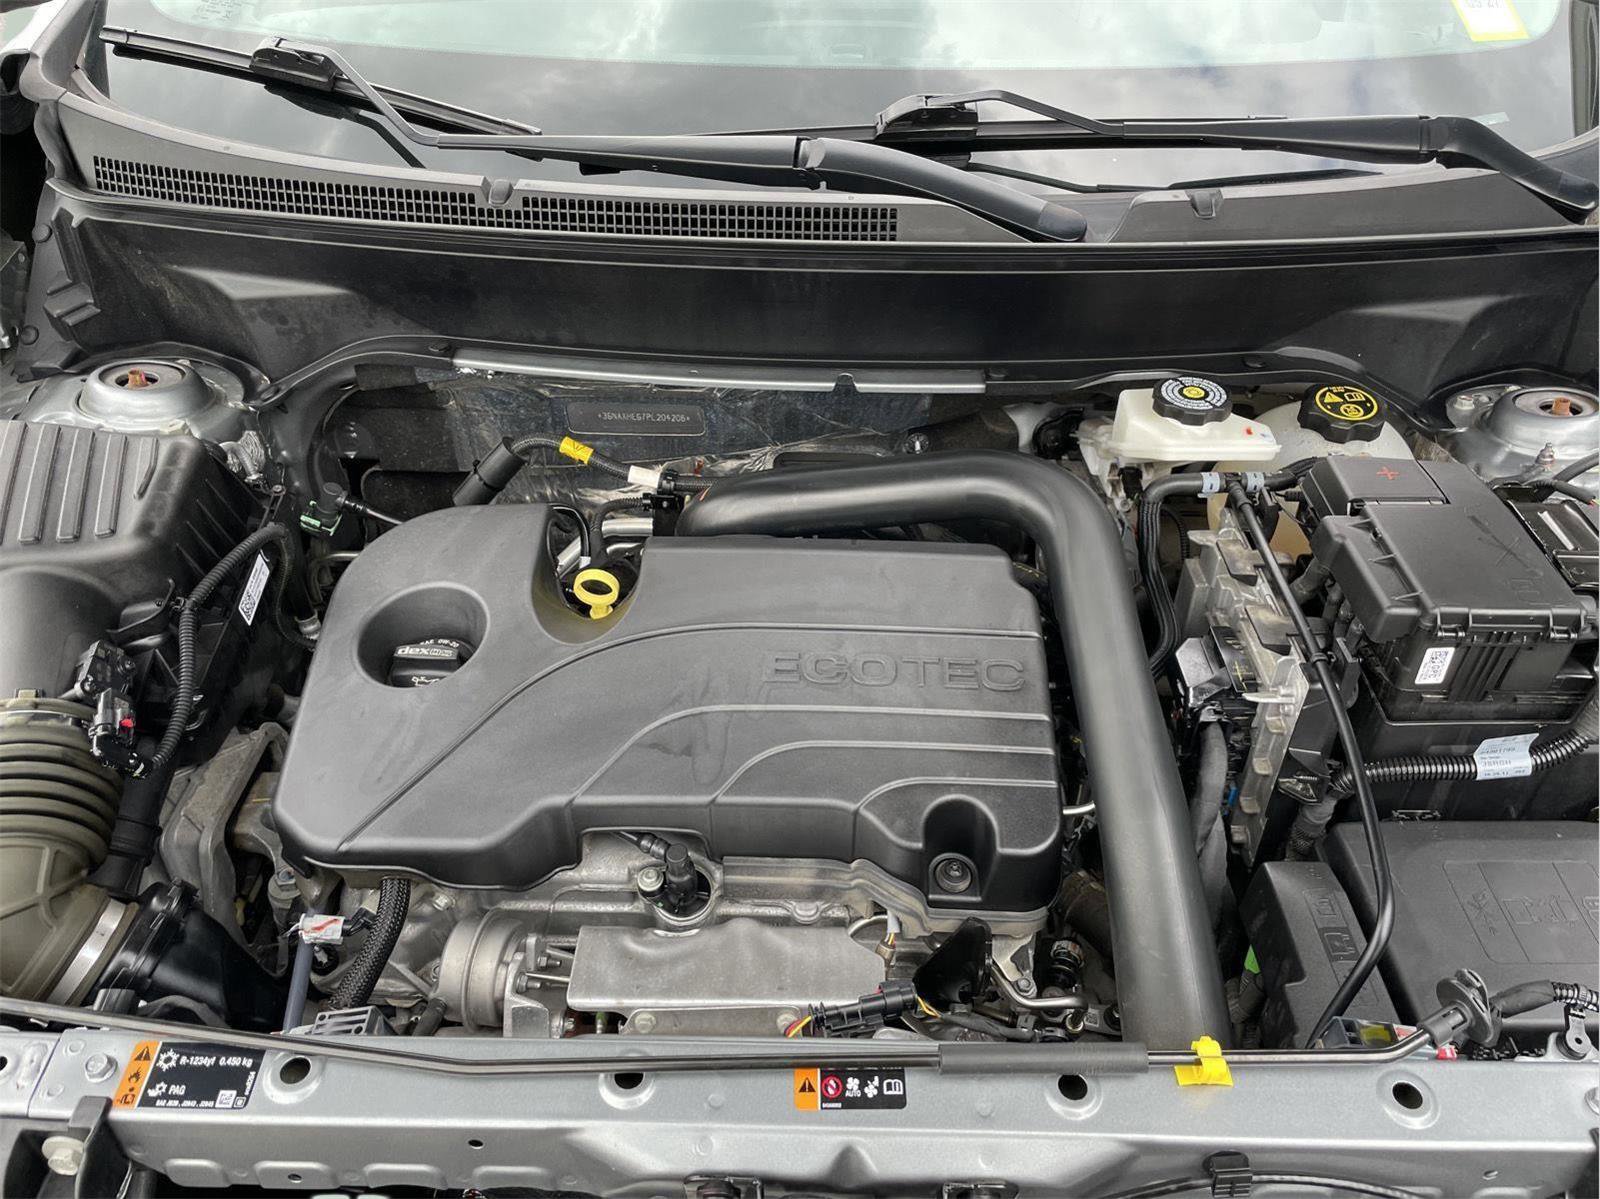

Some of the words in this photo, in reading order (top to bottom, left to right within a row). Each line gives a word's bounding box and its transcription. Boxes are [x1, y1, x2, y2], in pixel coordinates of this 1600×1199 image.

[764, 651, 1025, 692] ECOTEC
[179, 1056, 216, 1067] R-1234yf
[219, 1055, 241, 1066] 0.450
[242, 1056, 253, 1068] kg
[168, 1084, 186, 1095] PAG
